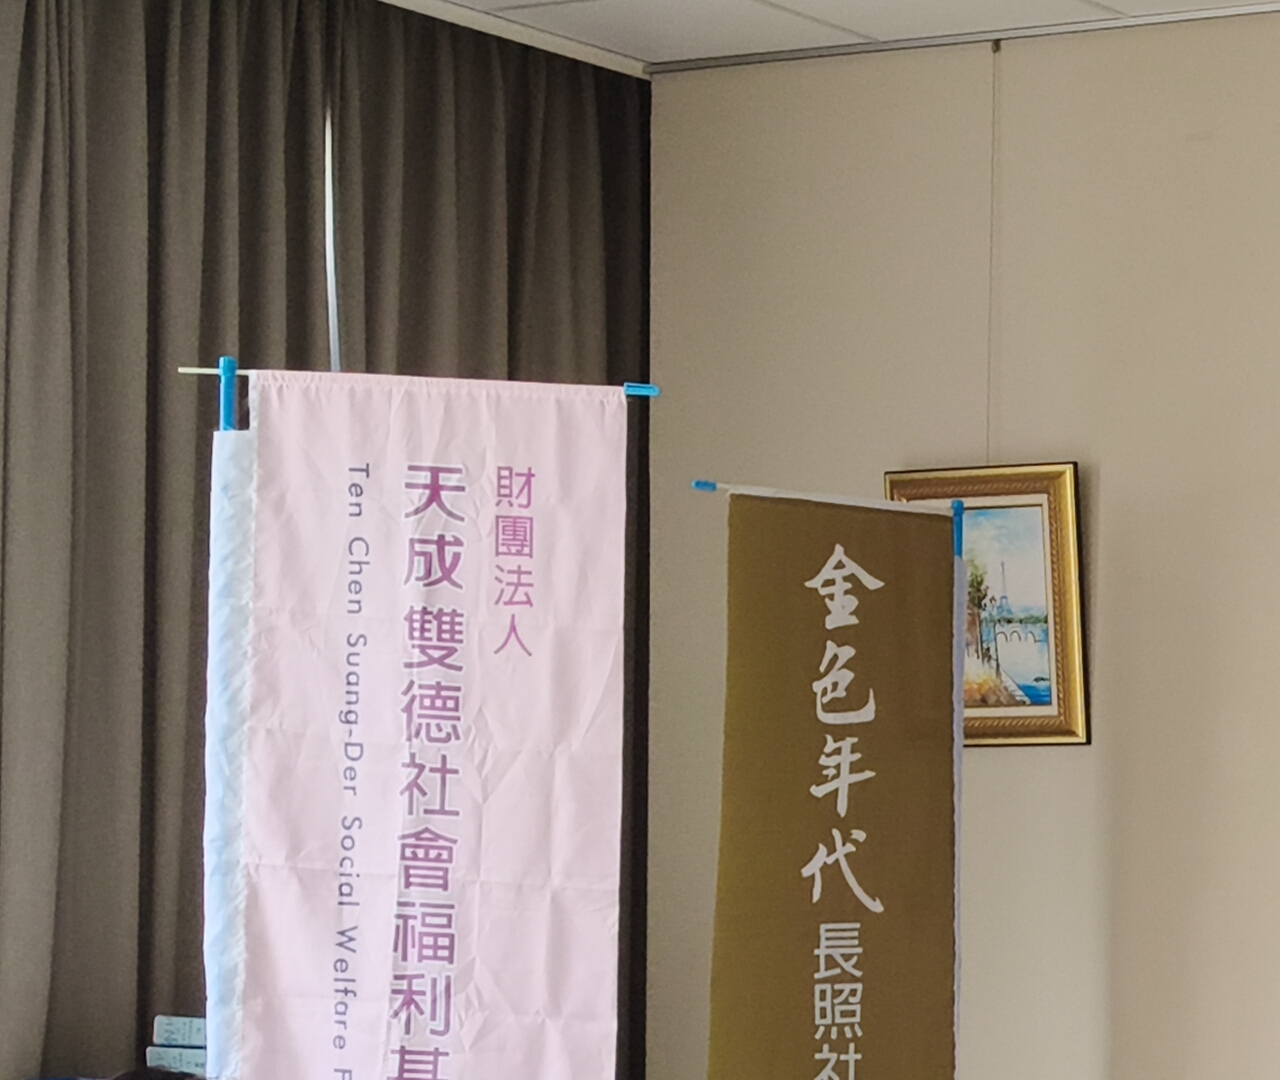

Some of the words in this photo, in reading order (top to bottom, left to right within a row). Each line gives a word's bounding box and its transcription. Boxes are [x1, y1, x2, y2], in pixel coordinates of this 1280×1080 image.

[348, 462, 370, 518] Ten
[346, 536, 370, 615] Chen
[494, 466, 536, 657] 財團法人
[339, 633, 368, 797] Suang-Der
[337, 816, 362, 907] Social
[333, 925, 359, 1051] Welfare
